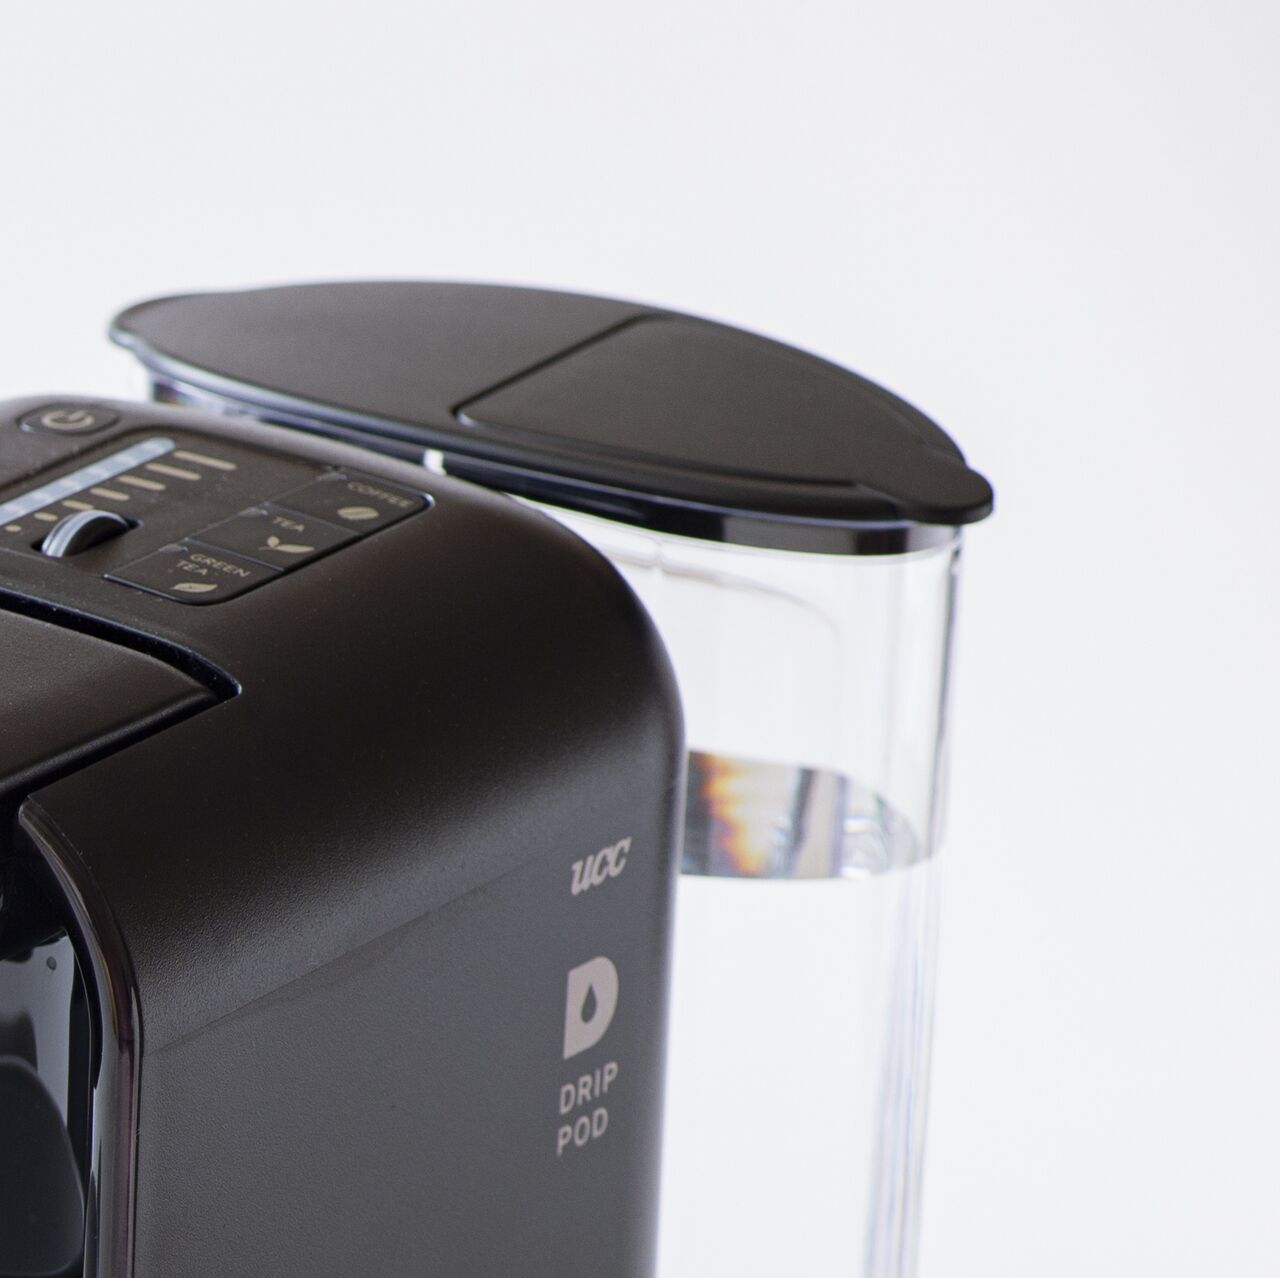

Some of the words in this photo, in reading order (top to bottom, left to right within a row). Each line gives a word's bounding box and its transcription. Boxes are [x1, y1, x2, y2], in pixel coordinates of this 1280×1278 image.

[347, 481, 414, 507] COFFEE
[273, 516, 305, 532] TEA
[176, 560, 208, 576] TEA
[190, 553, 251, 577] GREEN
[559, 1061, 618, 1115] DRIP
[557, 1107, 609, 1157] POD
